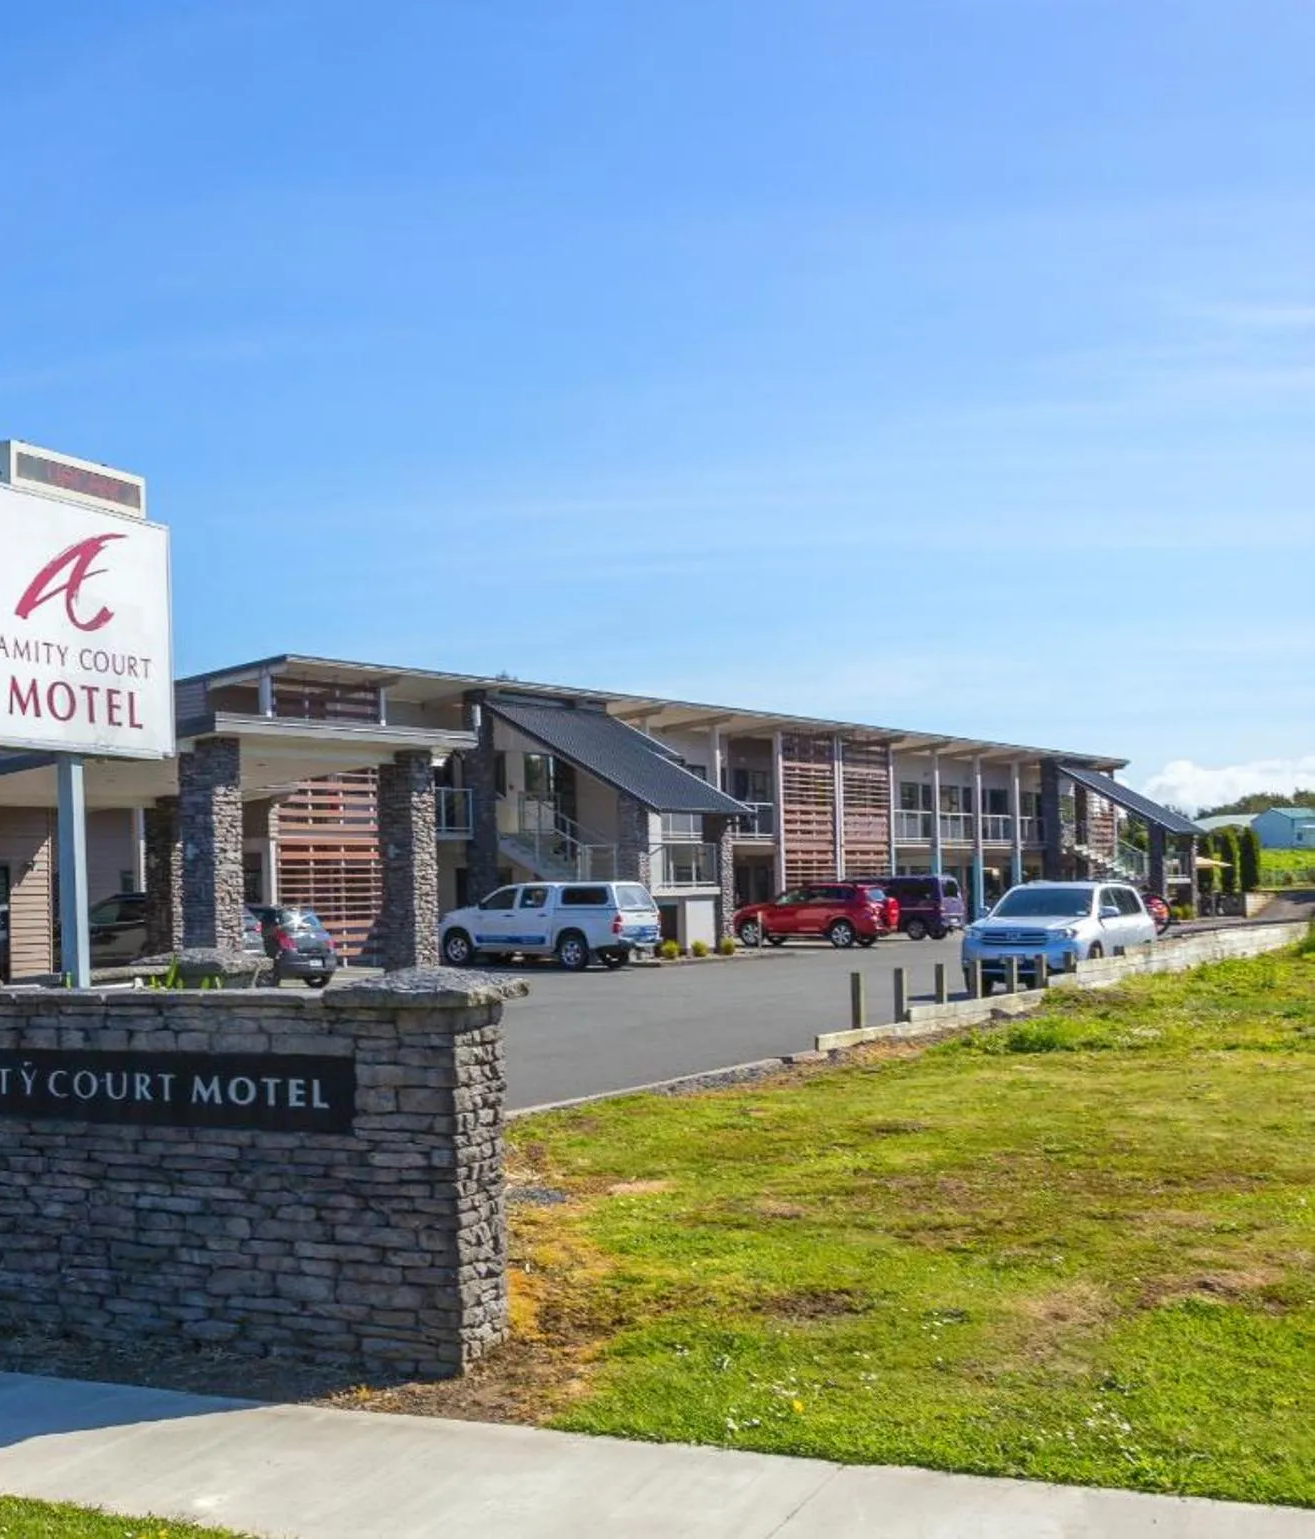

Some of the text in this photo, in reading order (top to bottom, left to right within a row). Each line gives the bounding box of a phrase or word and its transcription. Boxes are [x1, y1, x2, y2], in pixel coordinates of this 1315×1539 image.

[79, 647, 152, 680] COURT
[8, 675, 144, 730] MOTEL
[48, 1069, 177, 1102] COURT
[191, 1075, 330, 1110] MOTEL
